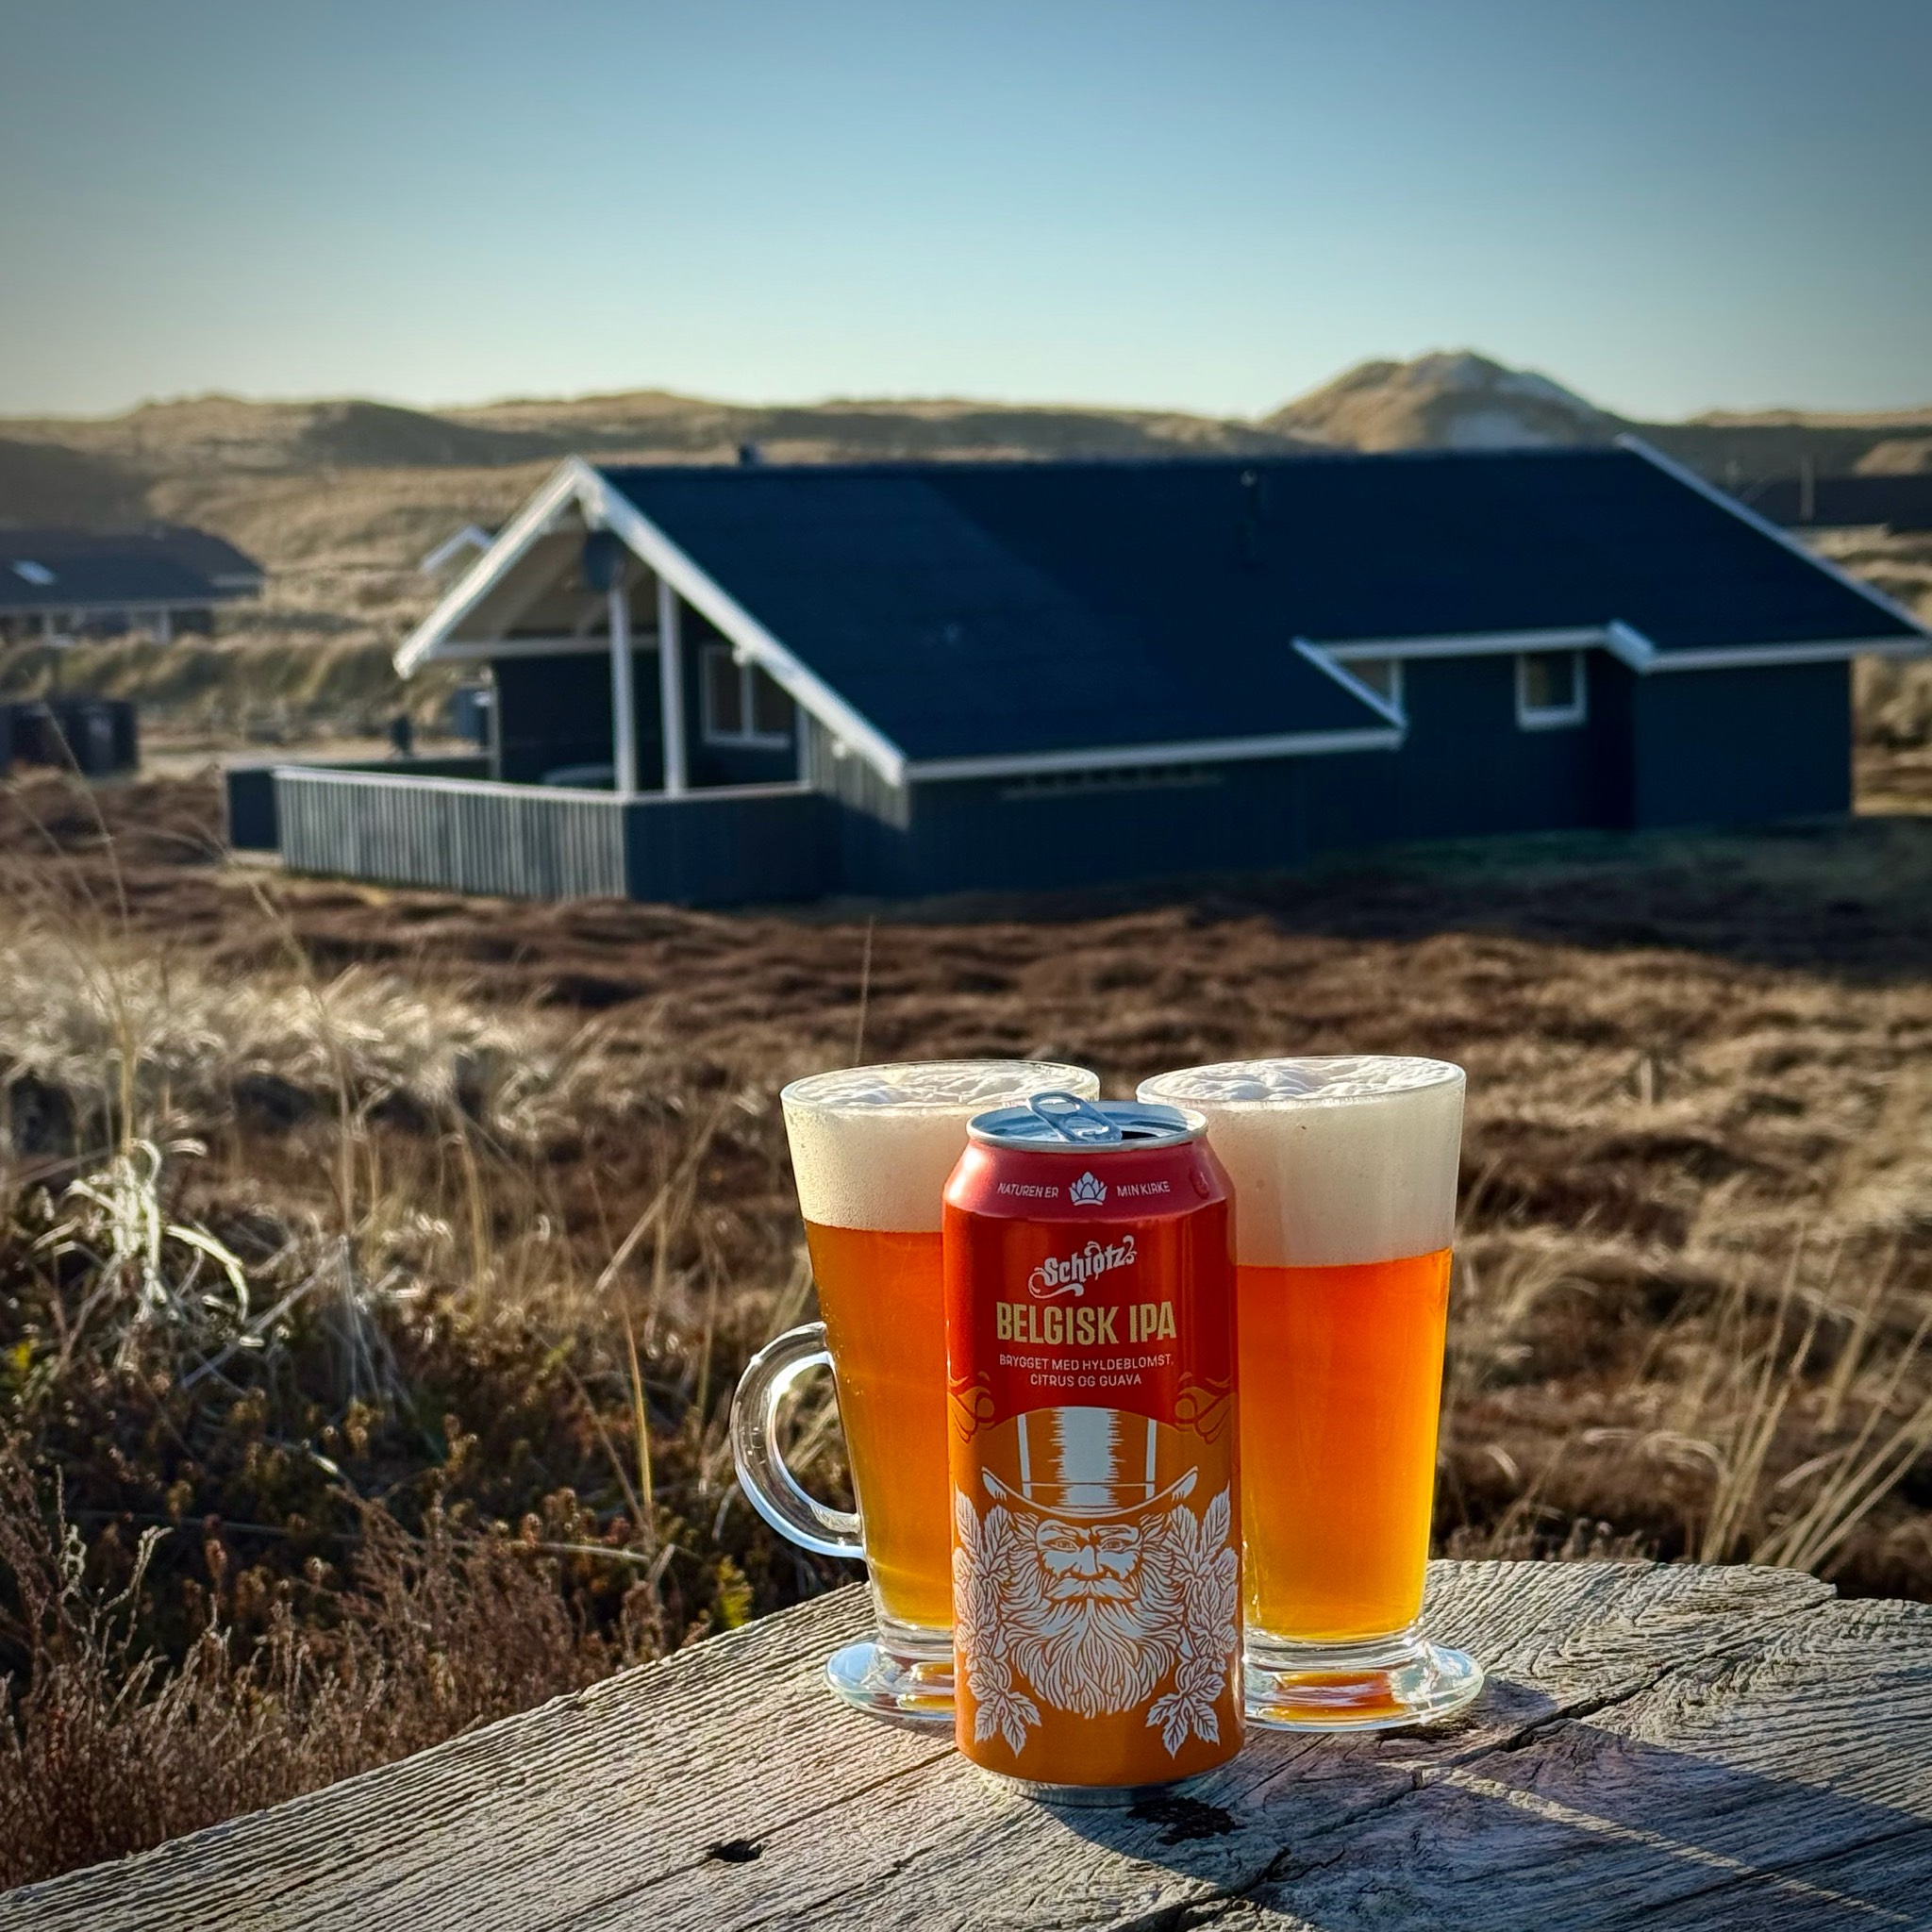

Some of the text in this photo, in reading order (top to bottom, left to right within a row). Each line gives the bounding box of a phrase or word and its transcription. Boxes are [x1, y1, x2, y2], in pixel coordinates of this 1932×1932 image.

[997, 1180, 1171, 1198] NATUREN ER MIN KIRKE
[996, 1300, 1176, 1345] BELGISK IPA
[999, 1354, 1049, 1370] BRYGGET
[1051, 1358, 1080, 1371] MED
[1030, 1374, 1142, 1387] CITRUS OG GUAVA
